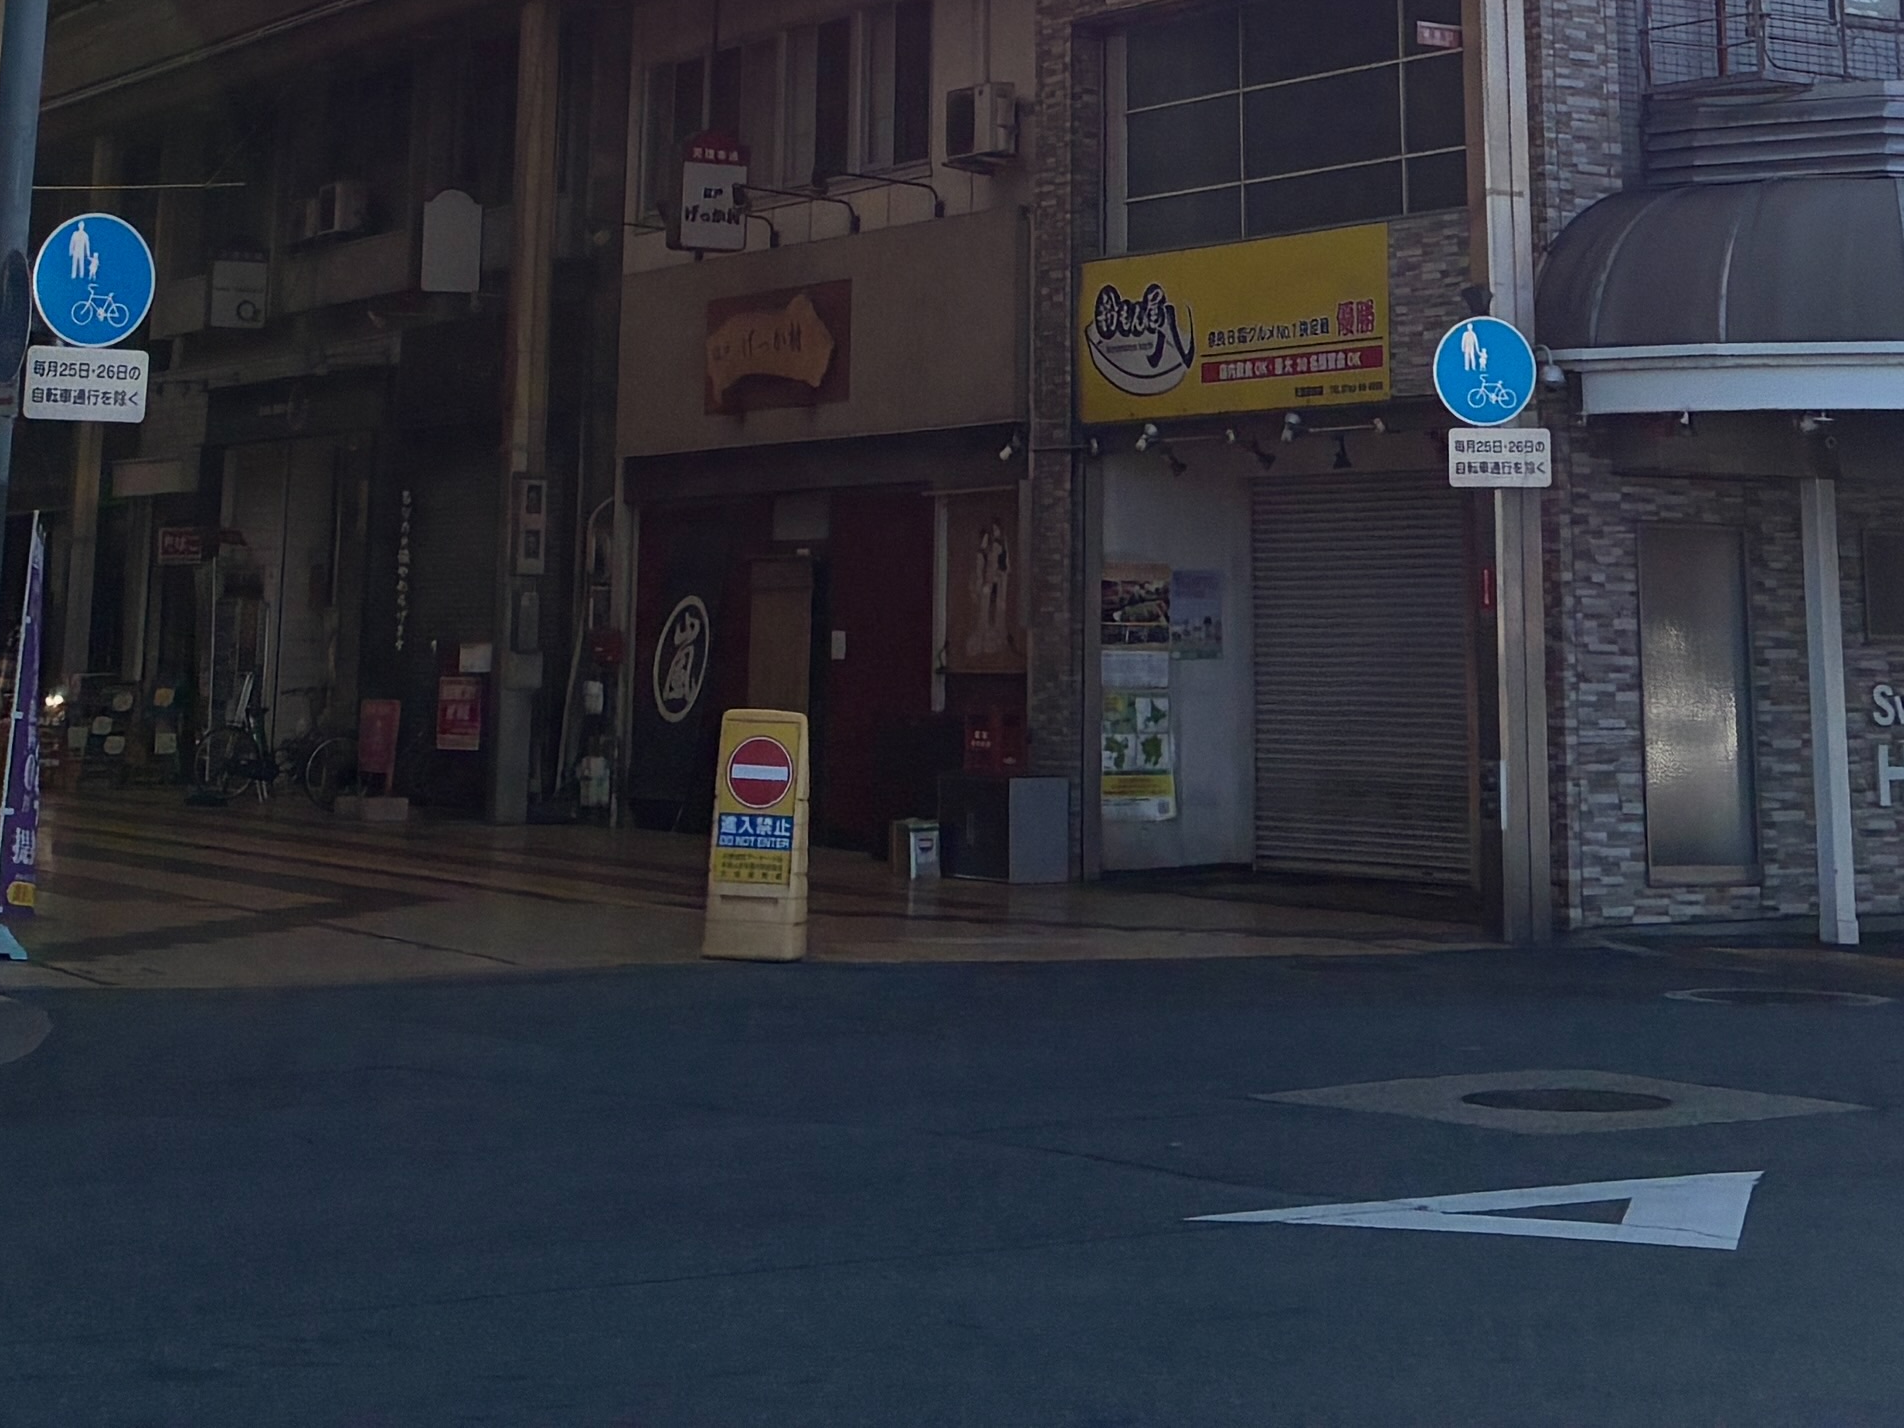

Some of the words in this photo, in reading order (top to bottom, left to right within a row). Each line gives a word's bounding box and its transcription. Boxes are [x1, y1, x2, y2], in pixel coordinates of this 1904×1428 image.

[33, 359, 142, 381] 毎月25日・26日の
[31, 387, 139, 407] 自転車通行を除く
[720, 815, 791, 837] 進入禁止
[719, 835, 734, 846] DO
[735, 836, 756, 847] NOT
[757, 836, 791, 849] ENTER
